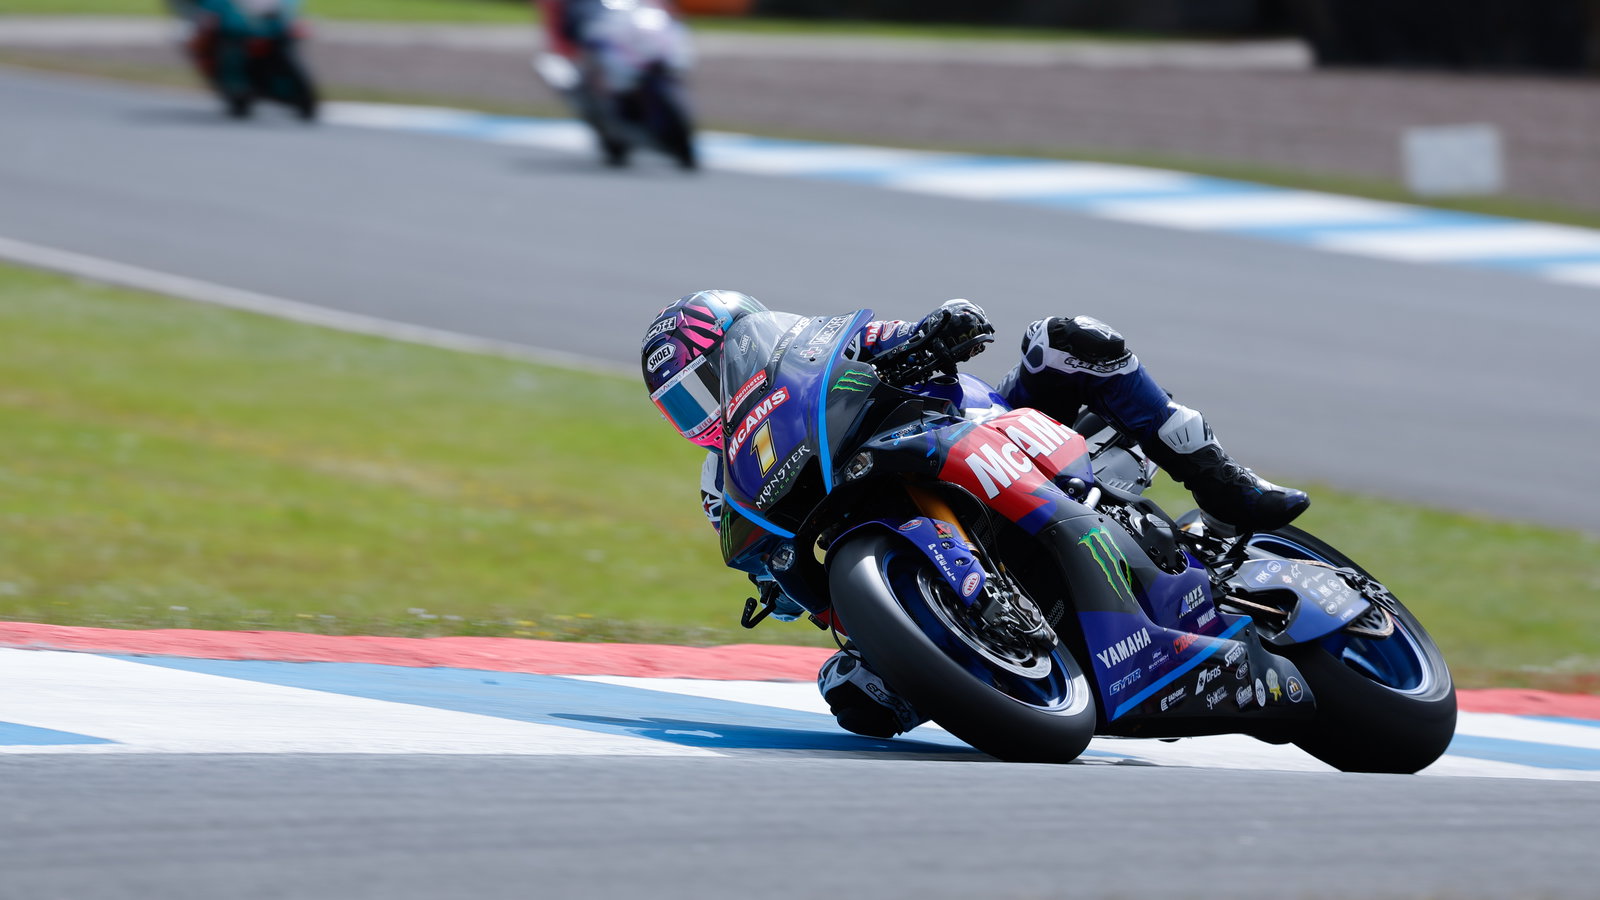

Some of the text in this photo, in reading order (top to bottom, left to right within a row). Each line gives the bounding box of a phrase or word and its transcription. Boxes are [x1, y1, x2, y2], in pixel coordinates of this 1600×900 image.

[649, 346, 671, 369] SHOEI
[750, 418, 778, 478] 1
[965, 409, 1080, 500] McAM
[928, 543, 957, 582] PIRELLI
[1096, 627, 1152, 669] YAMAHA
